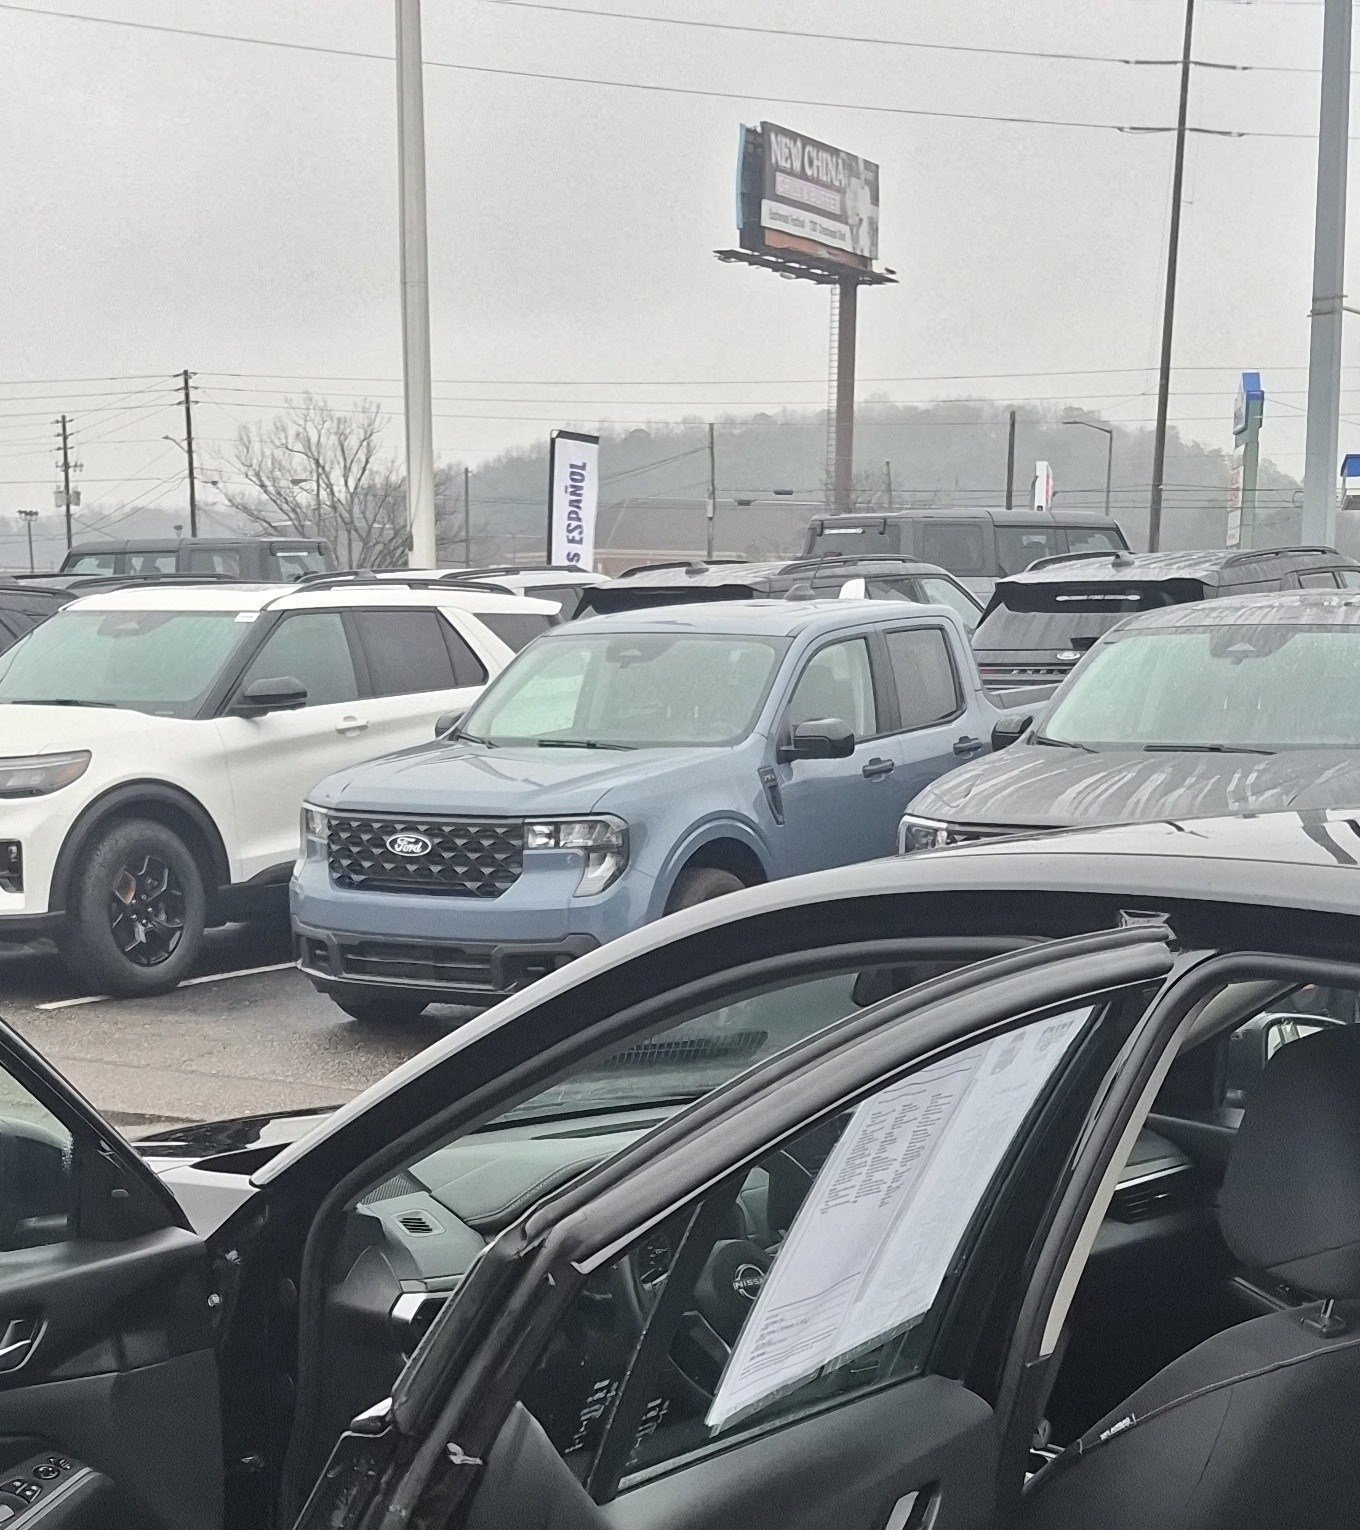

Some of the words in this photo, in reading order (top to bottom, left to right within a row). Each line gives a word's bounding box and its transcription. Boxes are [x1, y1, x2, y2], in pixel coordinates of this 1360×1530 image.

[770, 131, 802, 174] NEW
[804, 145, 847, 188] CHINA
[565, 462, 587, 545] ESPAÑOL
[394, 837, 423, 853] Ford
